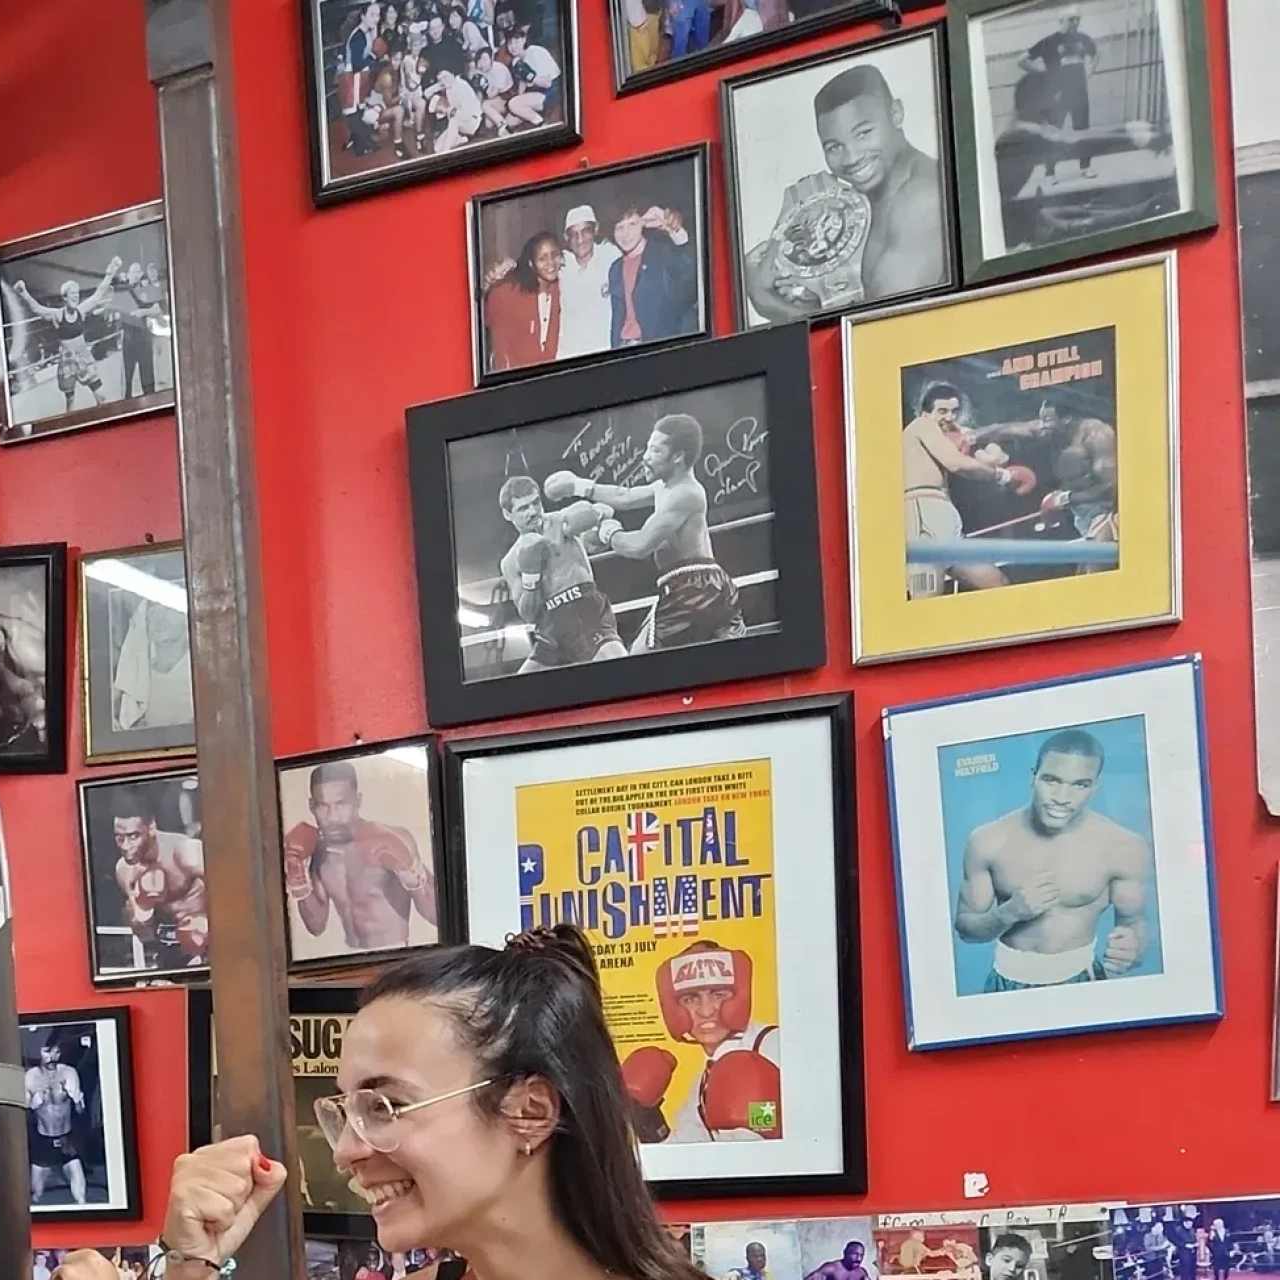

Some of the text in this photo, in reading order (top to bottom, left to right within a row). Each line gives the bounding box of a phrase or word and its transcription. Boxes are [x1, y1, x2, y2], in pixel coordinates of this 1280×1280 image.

[545, 586, 582, 610] ALEXIS
[616, 784, 629, 793] DAY
[638, 782, 651, 790] THE
[670, 779, 684, 788] CAN
[685, 776, 712, 786] LONDON
[713, 773, 730, 783] TAKE
[731, 773, 736, 781] A
[737, 771, 753, 780] BITE
[575, 797, 588, 806] OUT
[589, 796, 598, 805] OF
[599, 794, 612, 804] THE
[612, 792, 624, 803] BIG
[625, 790, 645, 801] APPLE
[646, 790, 654, 799] IN
[655, 788, 668, 798] THE
[685, 785, 704, 795] FIRST
[706, 783, 723, 793] EVER
[724, 782, 747, 791] WHITE
[575, 805, 600, 815] COLLAR
[601, 804, 626, 814] BOXING
[674, 797, 702, 806] LONDON
[577, 806, 750, 886] CAPITAL
[518, 844, 772, 940] PUNISHMENT
[591, 941, 657, 956] SDAY 13 JULY
[599, 957, 634, 969] ARENA
[290, 1018, 354, 1060] SUG
[751, 1112, 772, 1127] ice
